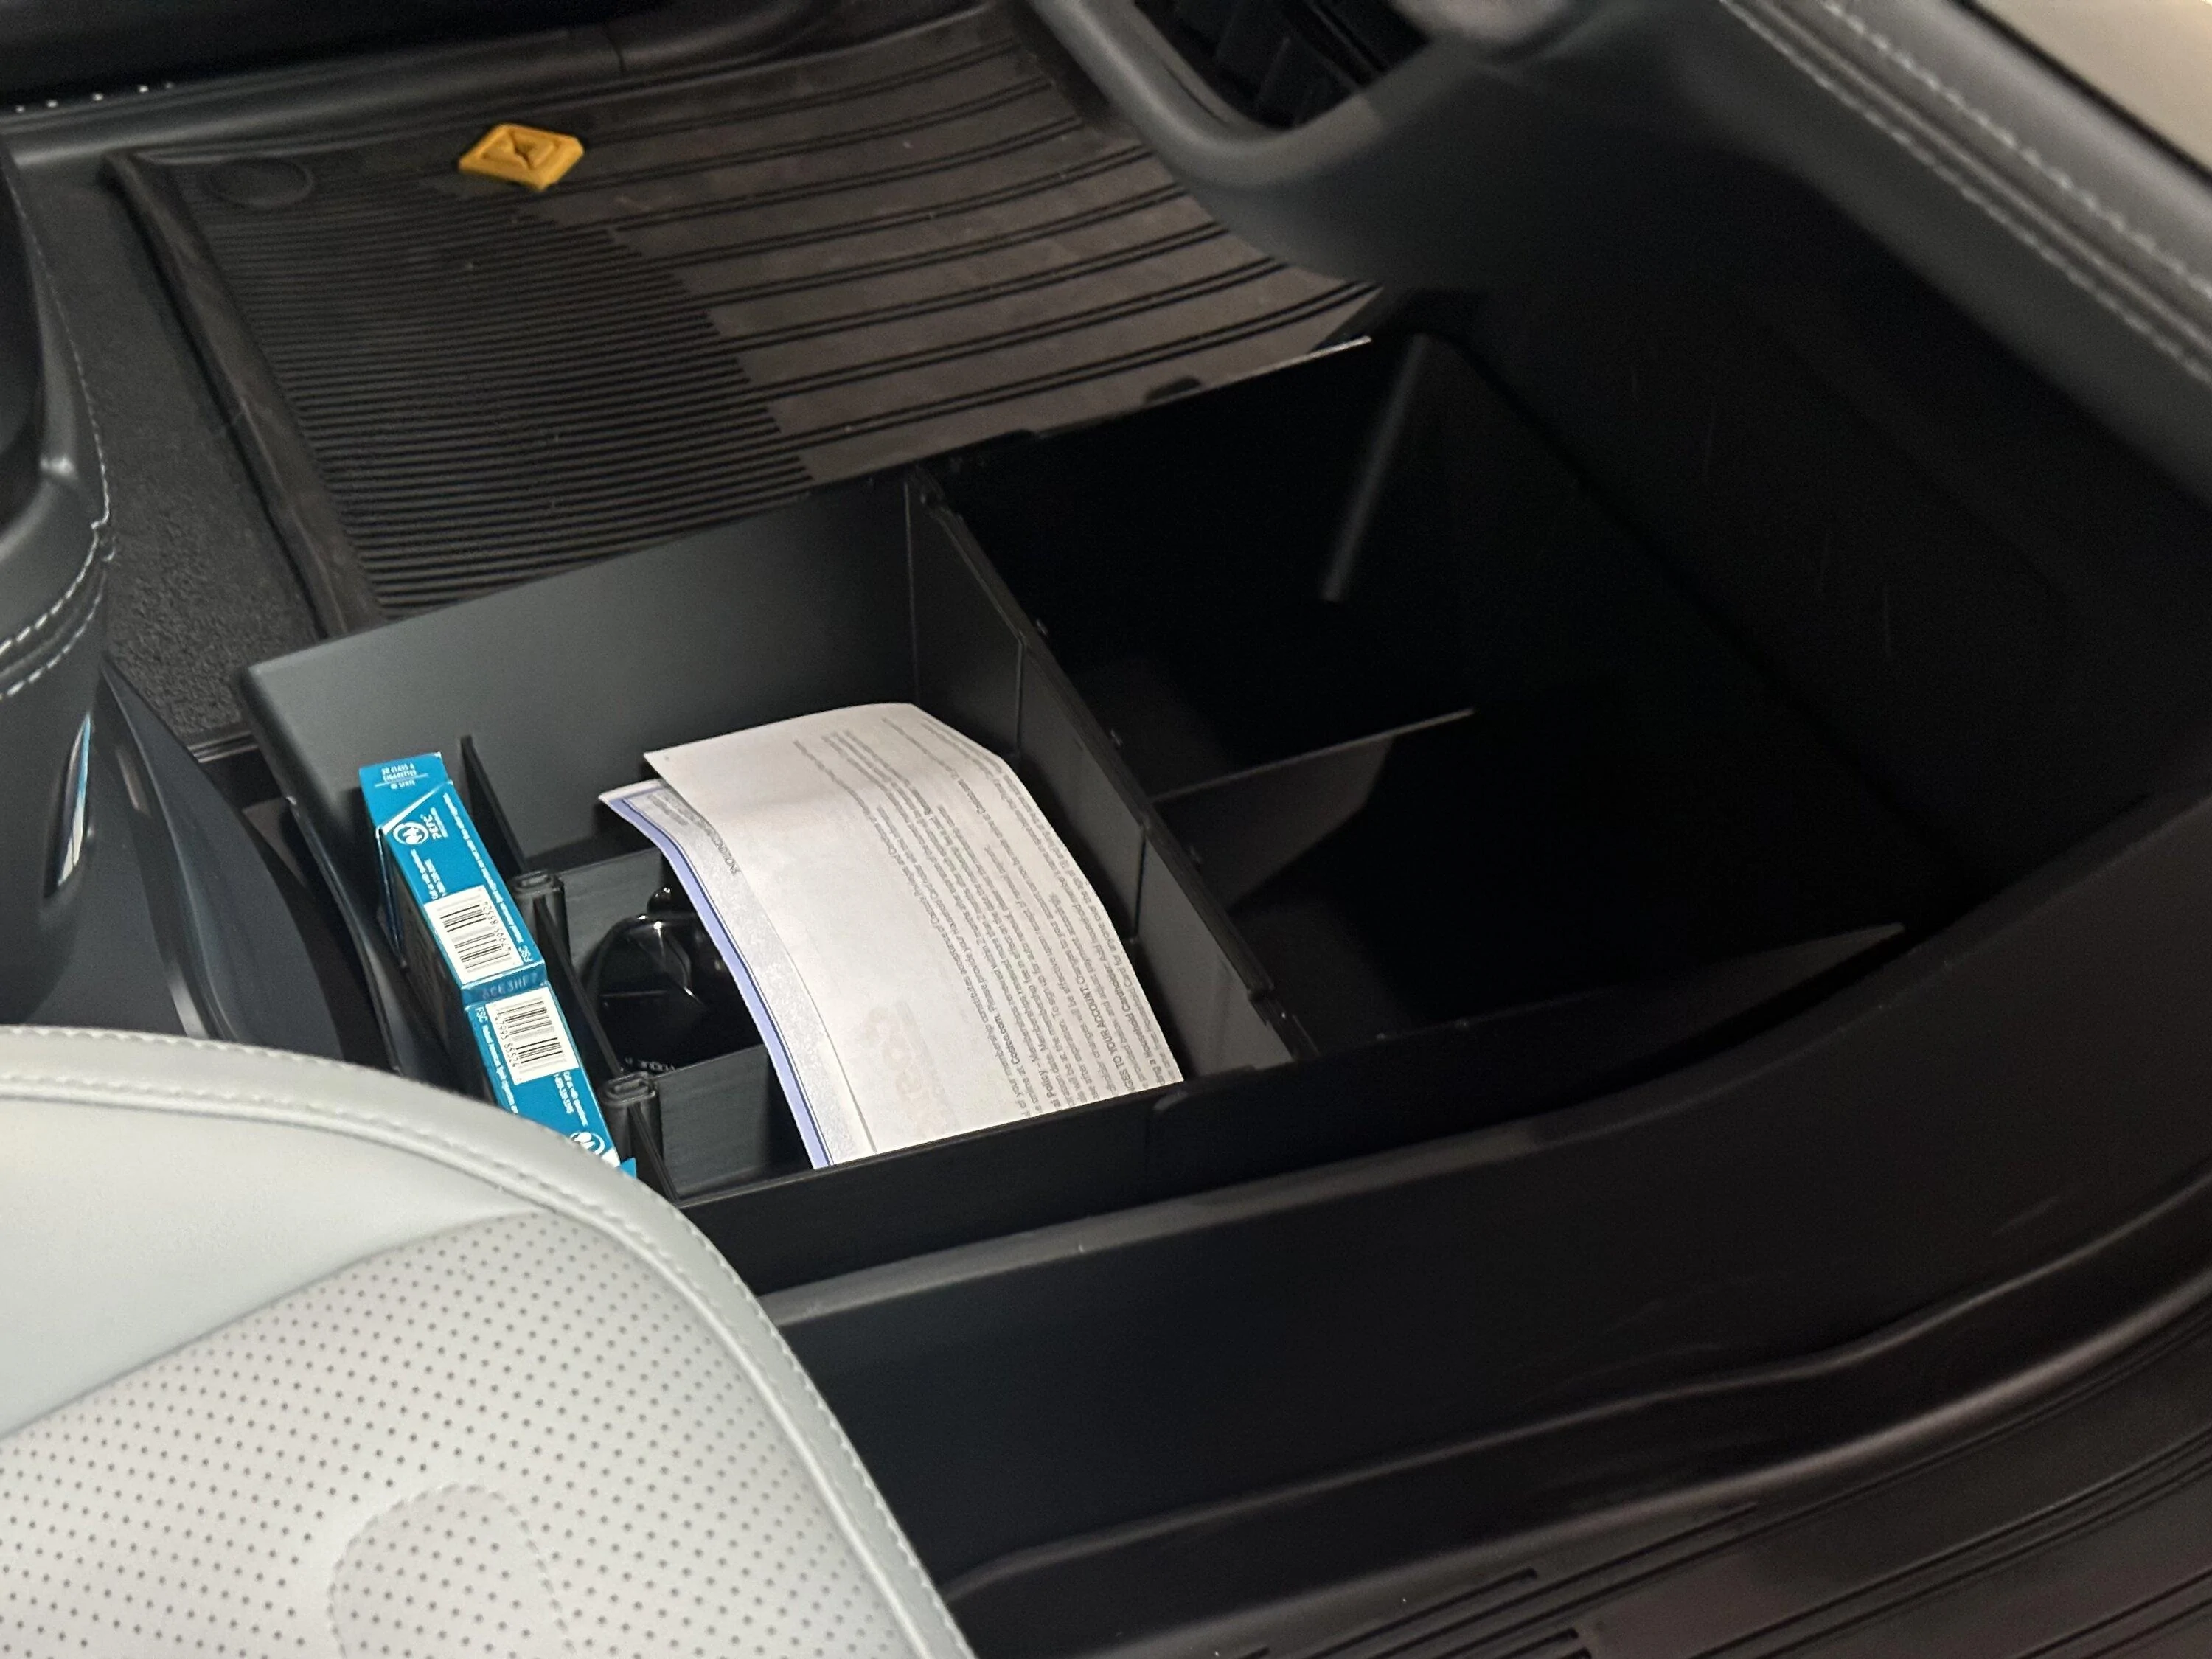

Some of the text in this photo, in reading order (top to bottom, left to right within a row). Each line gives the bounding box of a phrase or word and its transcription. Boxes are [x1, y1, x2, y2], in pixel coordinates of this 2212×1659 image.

[516, 944, 534, 962] FSC
[476, 1006, 490, 1023] FSC
[1099, 1028, 1119, 1054] YOUR
[1124, 1012, 1153, 1058] Household
[1036, 1068, 1059, 1098] Policy
